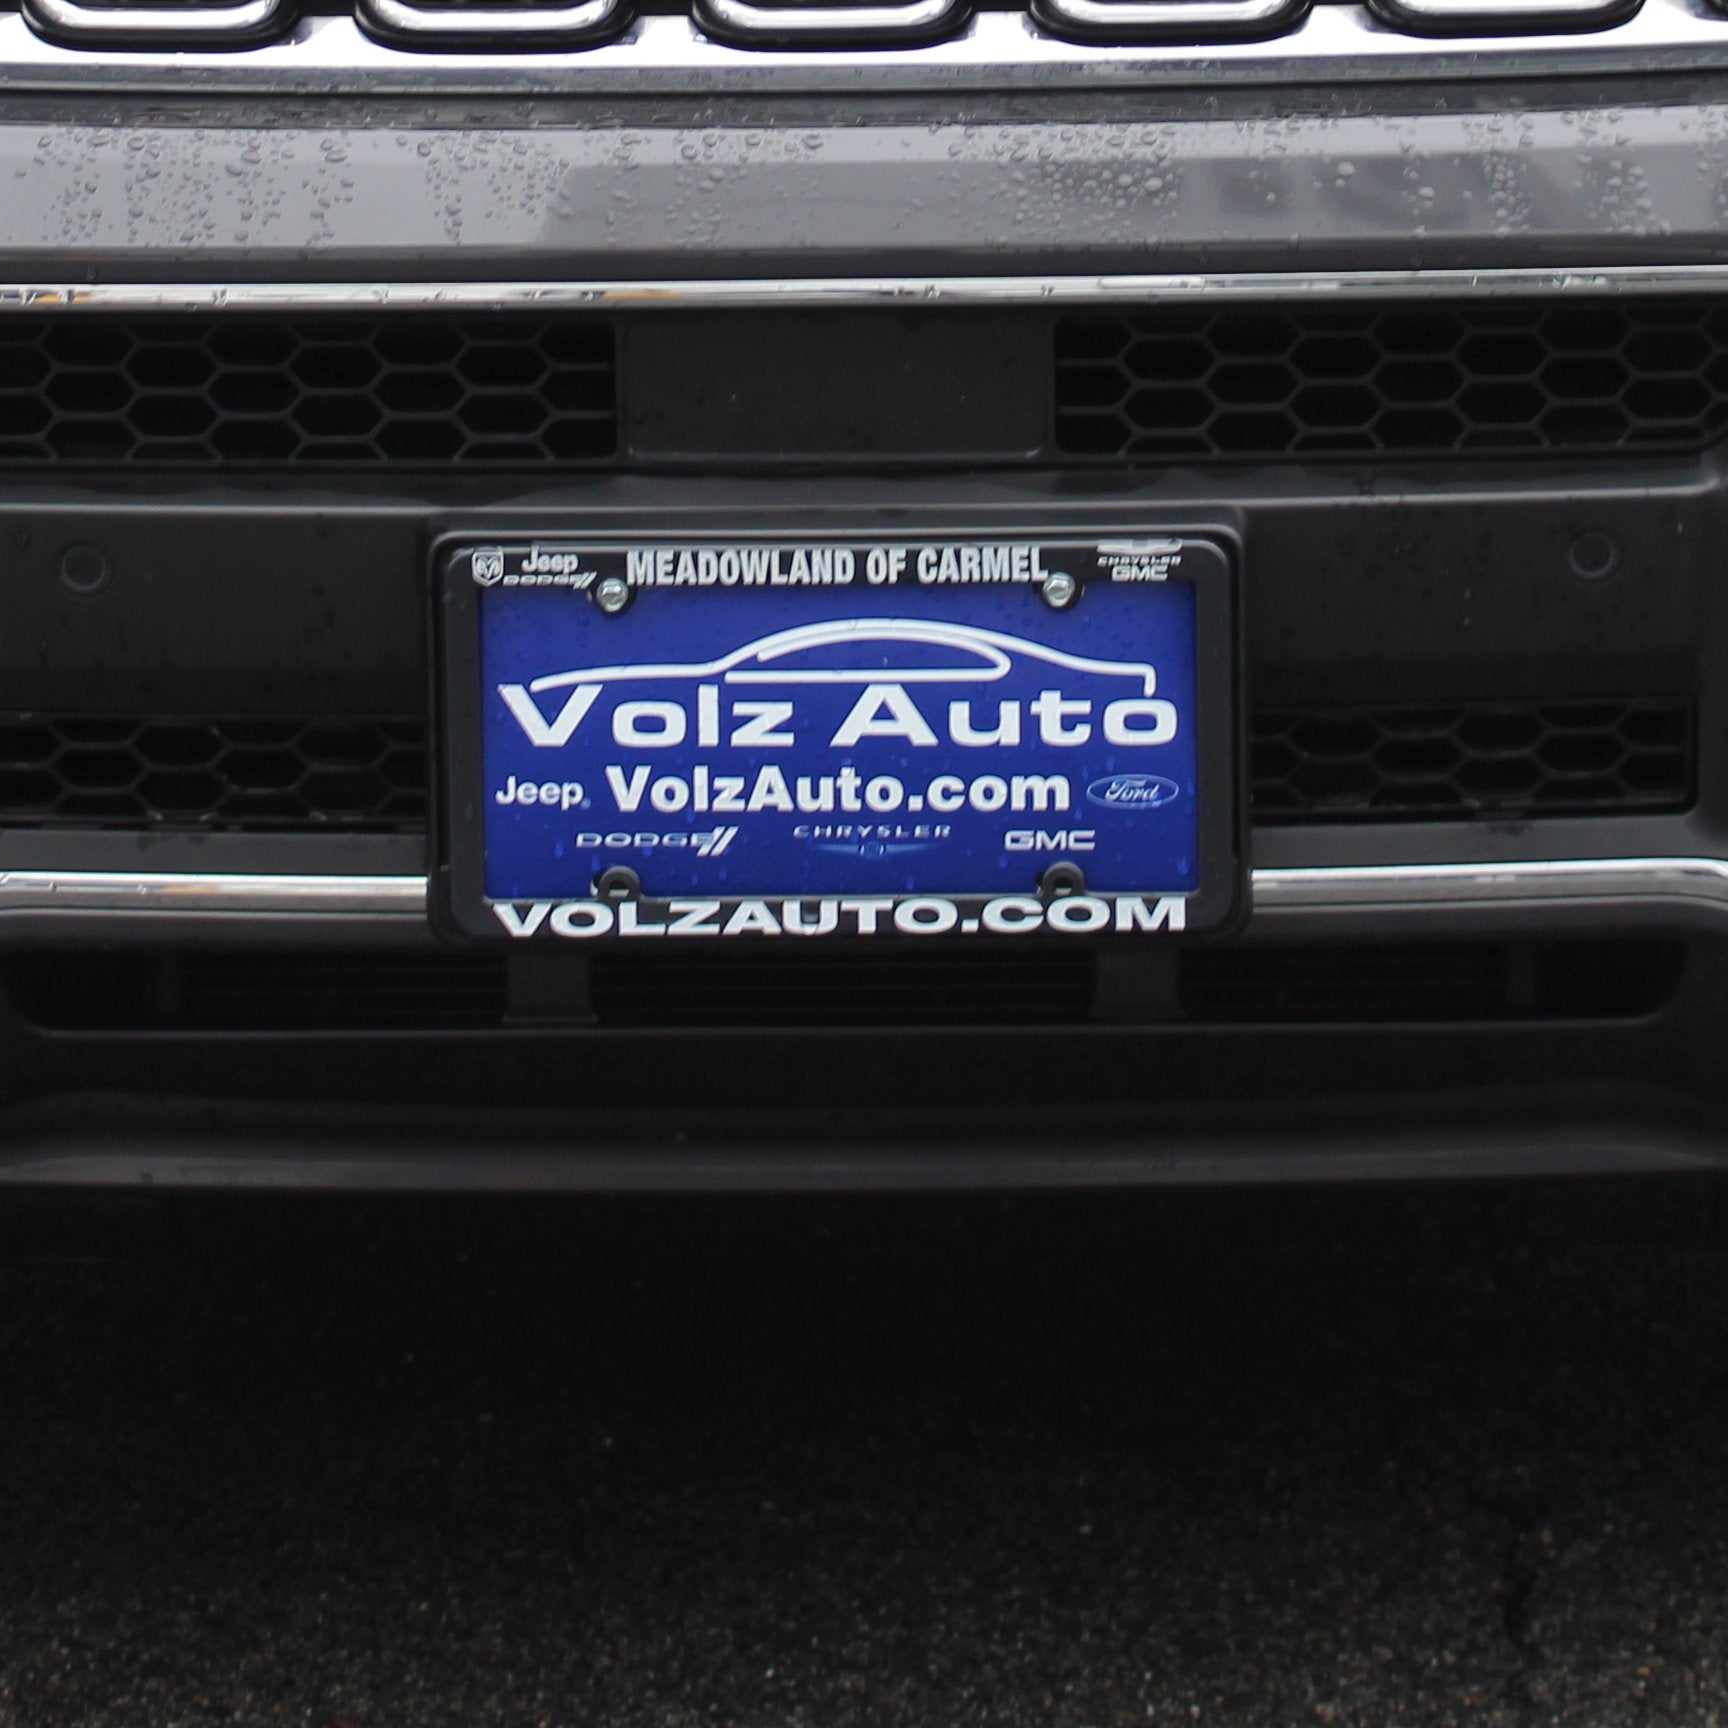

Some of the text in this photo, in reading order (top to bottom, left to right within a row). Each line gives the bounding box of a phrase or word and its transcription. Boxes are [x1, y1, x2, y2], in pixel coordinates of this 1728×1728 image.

[521, 544, 579, 575] Jeep
[626, 545, 1049, 586] MEADOWLAND OF CARMEL
[1111, 565, 1169, 582] GMC
[498, 682, 1178, 747] Volz Auto
[495, 775, 584, 811] Jeep
[605, 765, 1070, 813] VolzAuto.com
[575, 830, 721, 851] DODGE
[792, 824, 952, 839] CHRYSLER
[1004, 829, 1096, 851] GMC
[492, 895, 1186, 938] VOLZAUTO.COM
